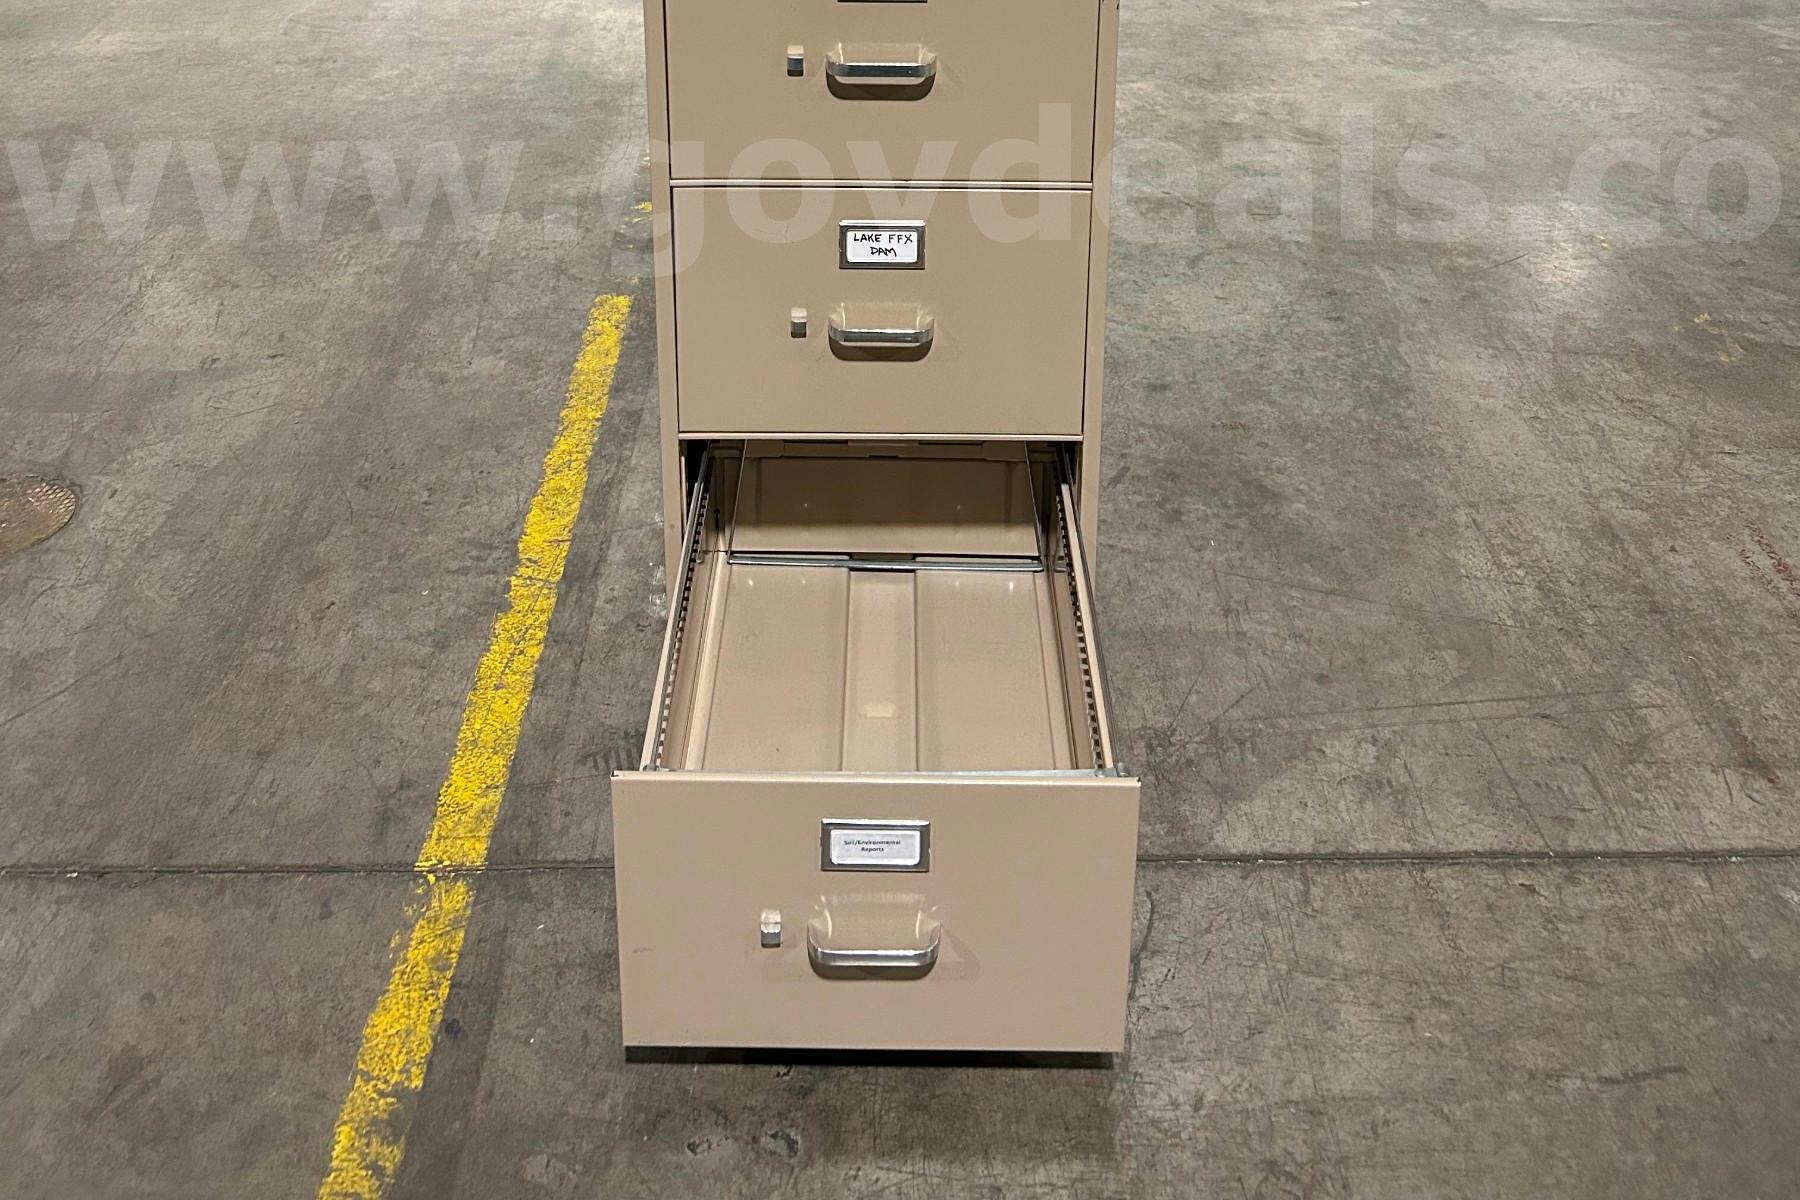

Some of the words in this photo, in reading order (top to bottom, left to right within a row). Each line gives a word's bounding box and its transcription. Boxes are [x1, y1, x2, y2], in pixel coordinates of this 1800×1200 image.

[853, 233, 882, 243] LAKE
[888, 234, 913, 245] FFX
[870, 246, 897, 257] DAM
